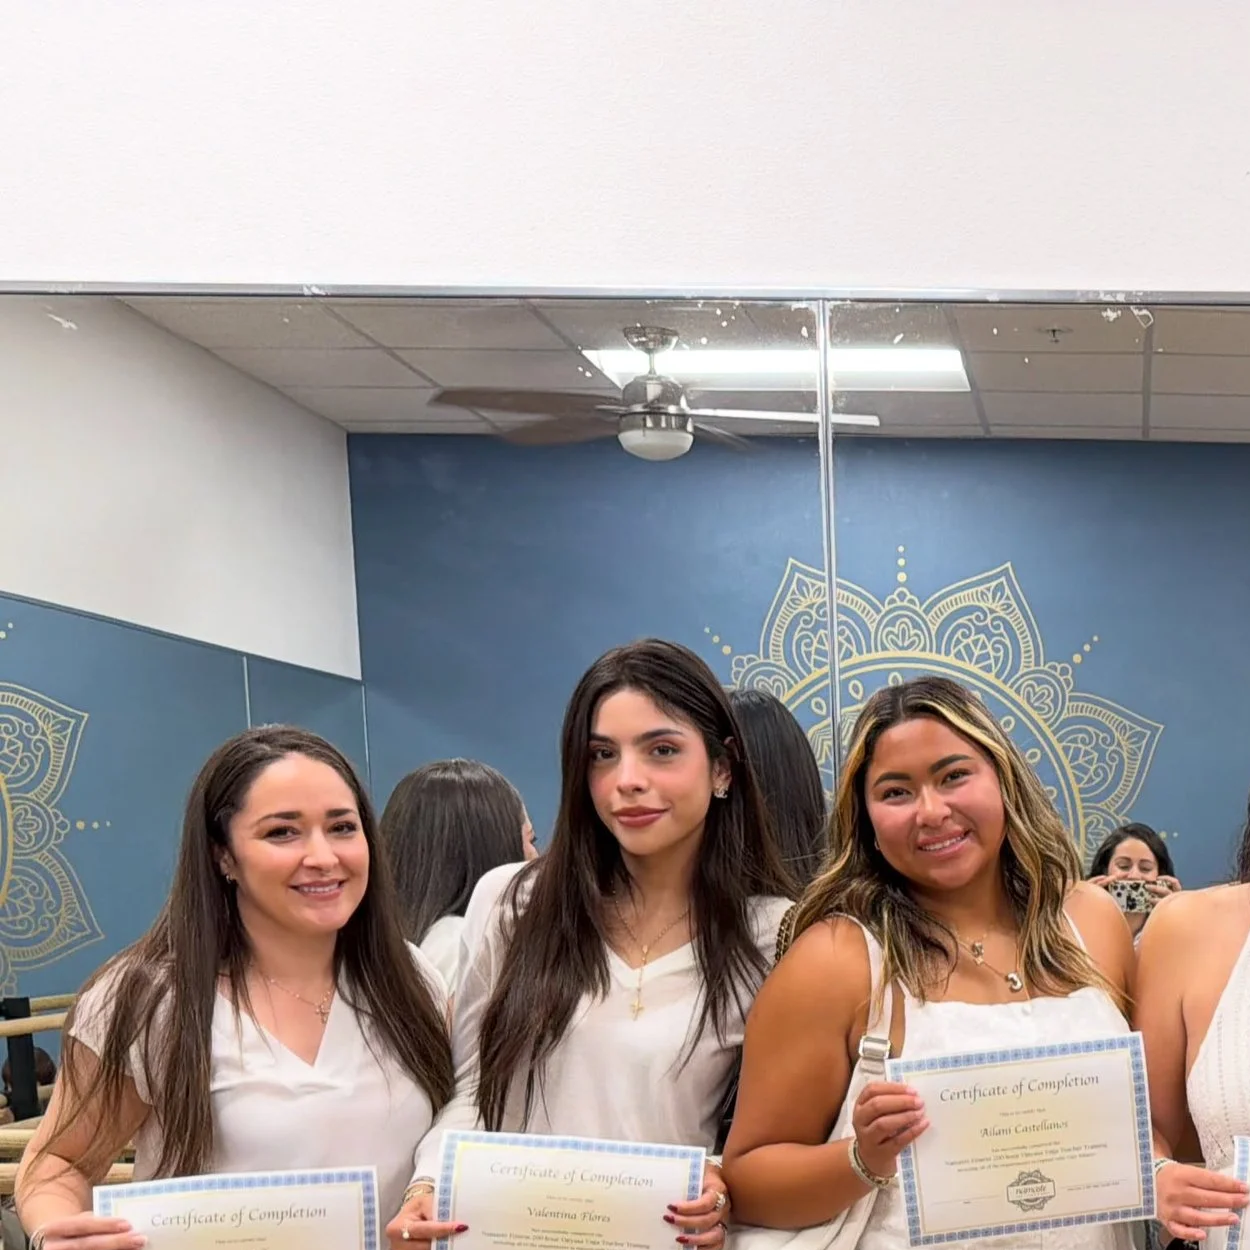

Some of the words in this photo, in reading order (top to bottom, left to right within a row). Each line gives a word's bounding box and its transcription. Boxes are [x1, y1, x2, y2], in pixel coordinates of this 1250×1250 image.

[940, 1083, 1008, 1104] Certificate
[1012, 1078, 1026, 1099] of
[1028, 1073, 1100, 1095] Completion
[490, 1161, 559, 1181] Certificate
[562, 1168, 576, 1184] of
[580, 1170, 655, 1189] Completion
[151, 1207, 226, 1230] Certificate
[230, 1206, 244, 1227] of
[248, 1204, 328, 1227] Completion
[527, 1206, 578, 1222] Valentina
[580, 1209, 611, 1224] Flores
